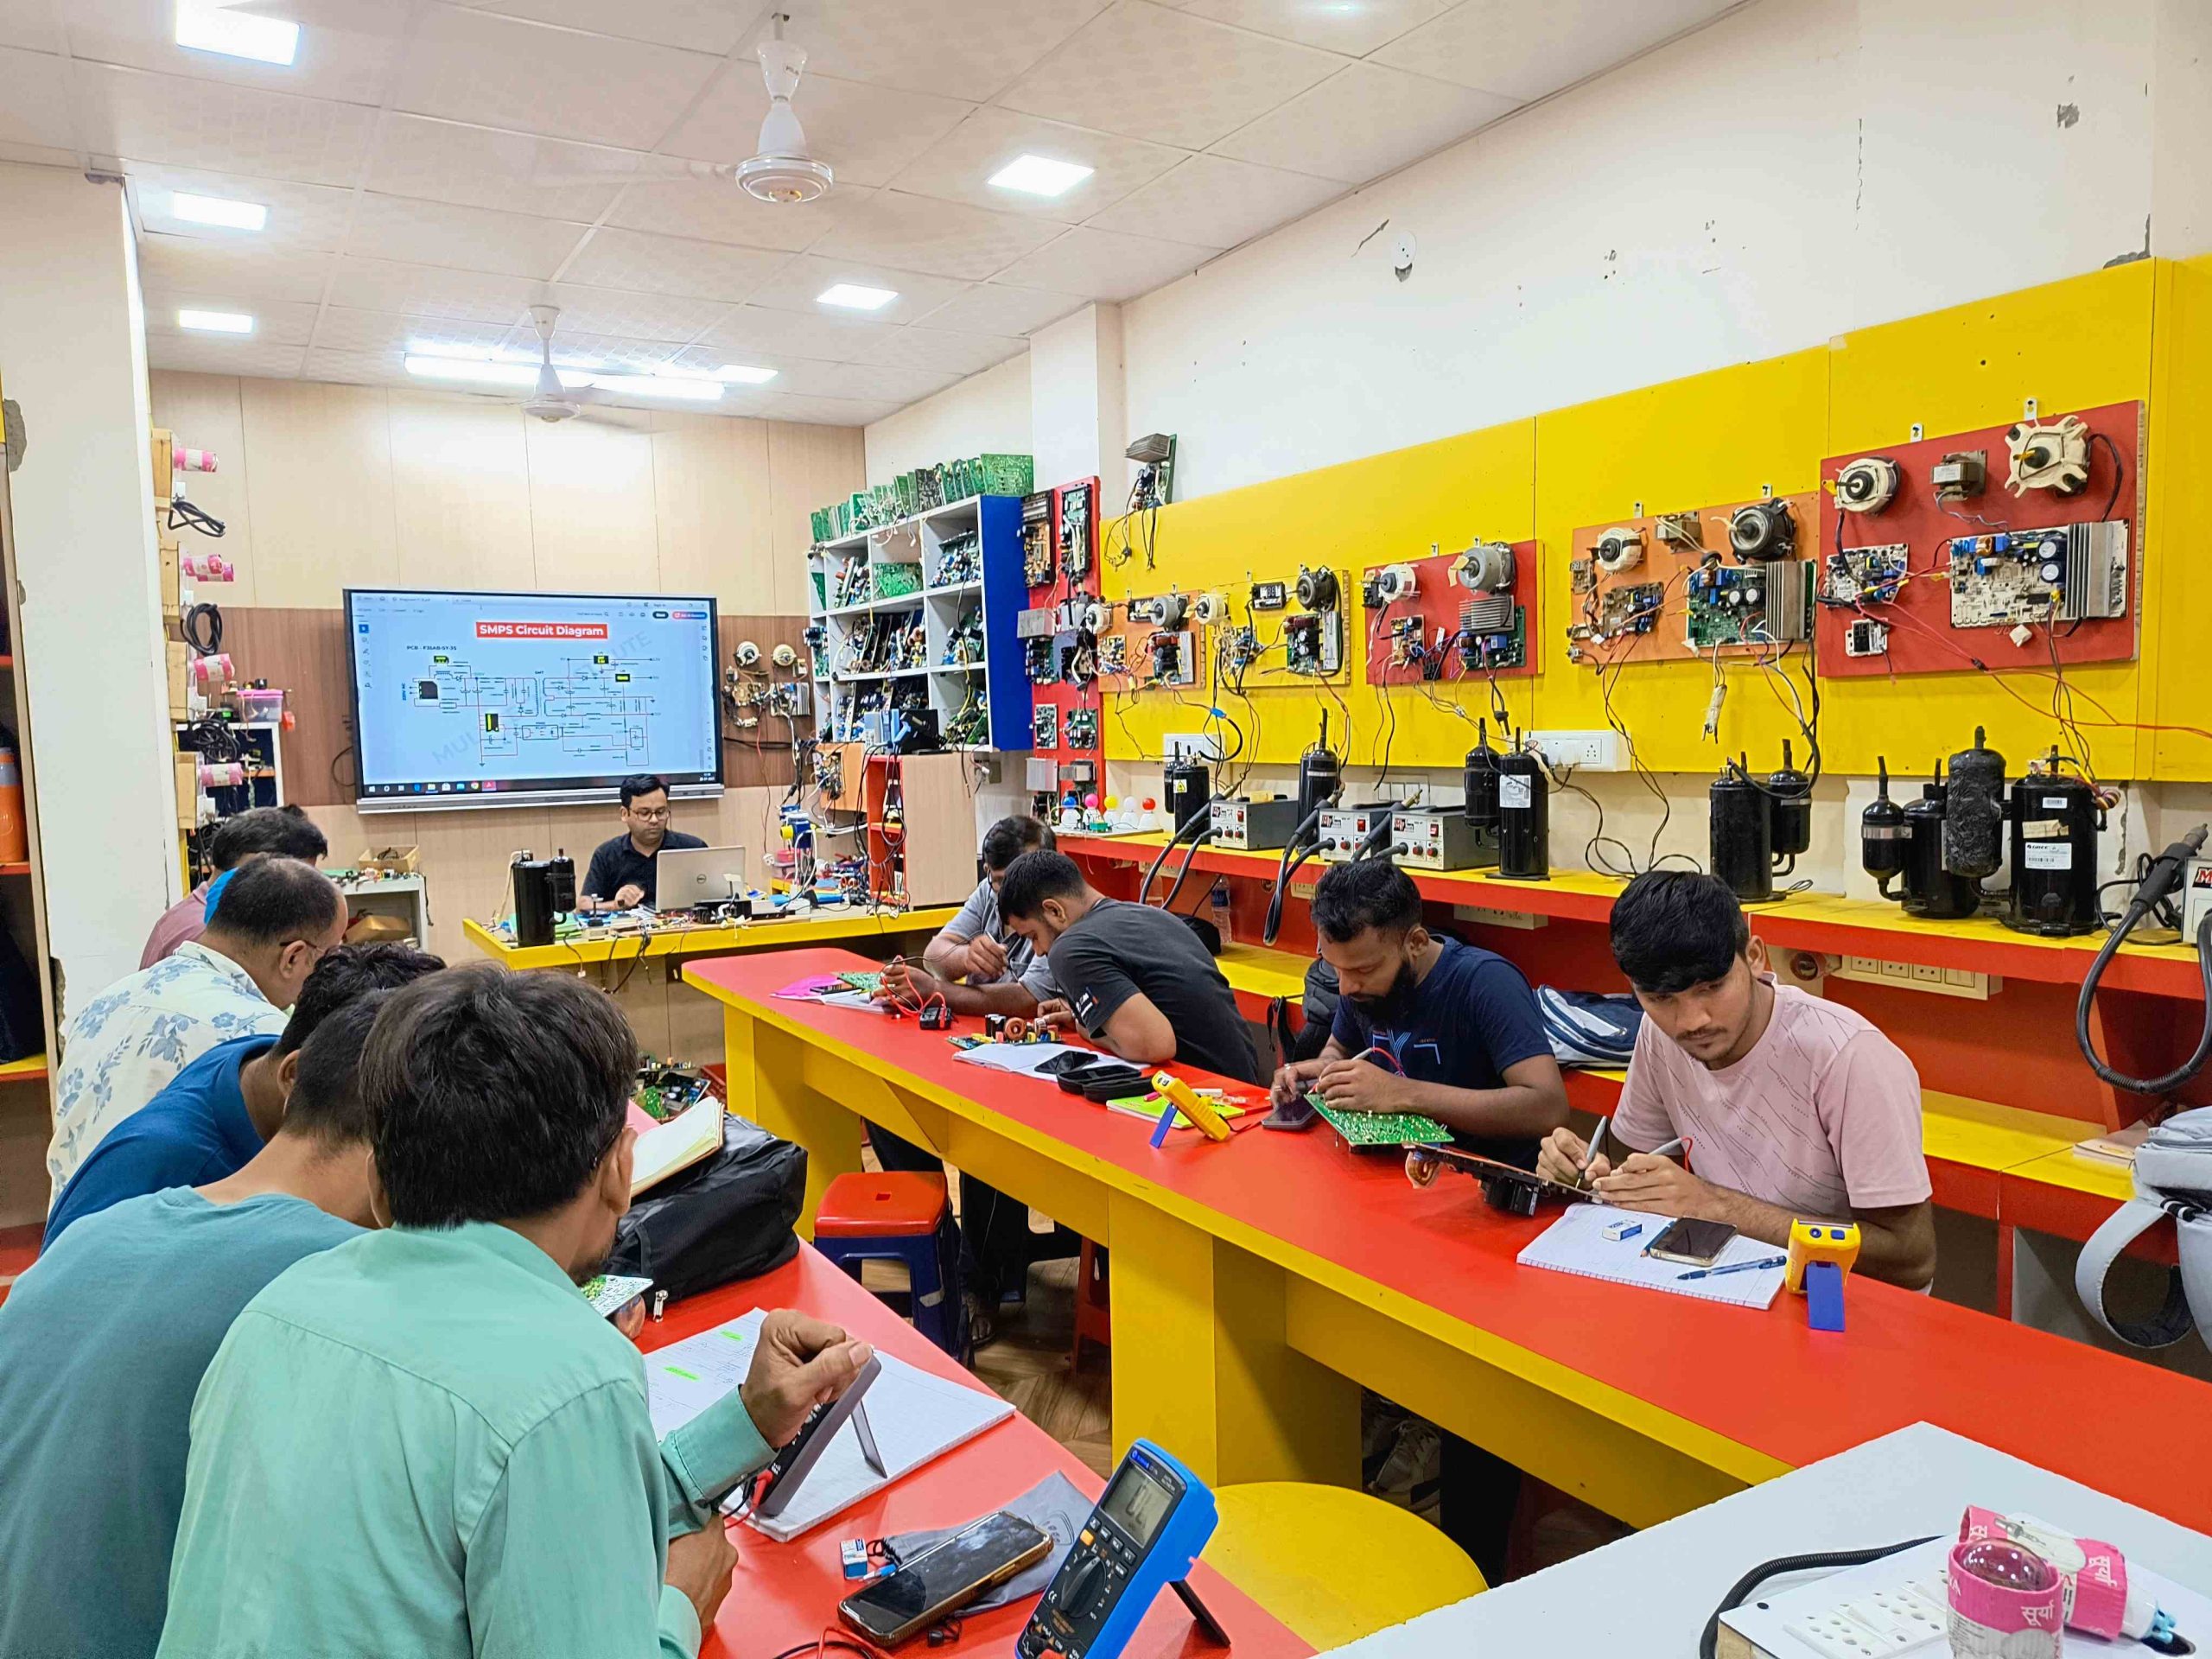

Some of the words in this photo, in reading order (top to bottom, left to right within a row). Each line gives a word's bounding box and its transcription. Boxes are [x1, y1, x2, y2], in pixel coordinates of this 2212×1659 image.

[480, 625, 512, 635] SMPS
[516, 626, 553, 635] Circuit
[556, 626, 604, 637] Diagram
[2020, 1599, 2055, 1627] सूर्या
